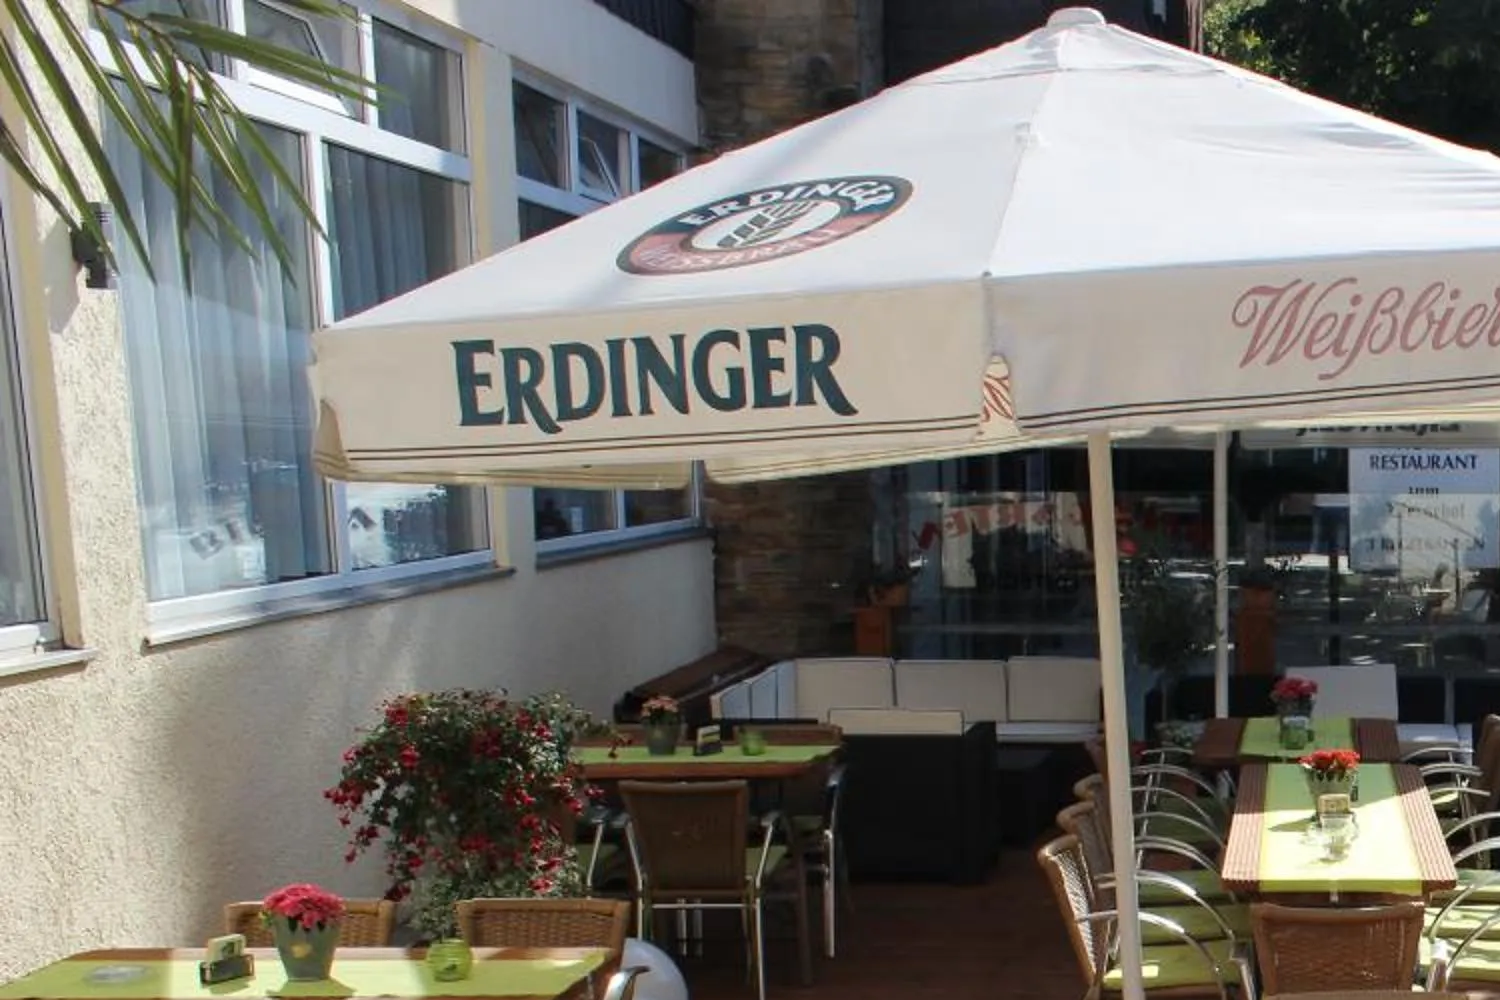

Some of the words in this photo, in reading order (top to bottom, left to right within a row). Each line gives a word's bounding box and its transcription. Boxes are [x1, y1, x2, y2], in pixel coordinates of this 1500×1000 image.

[677, 180, 895, 226] ERDINGER
[451, 322, 859, 435] ERDINGER
[1369, 454, 1479, 470] RESTAURANT
